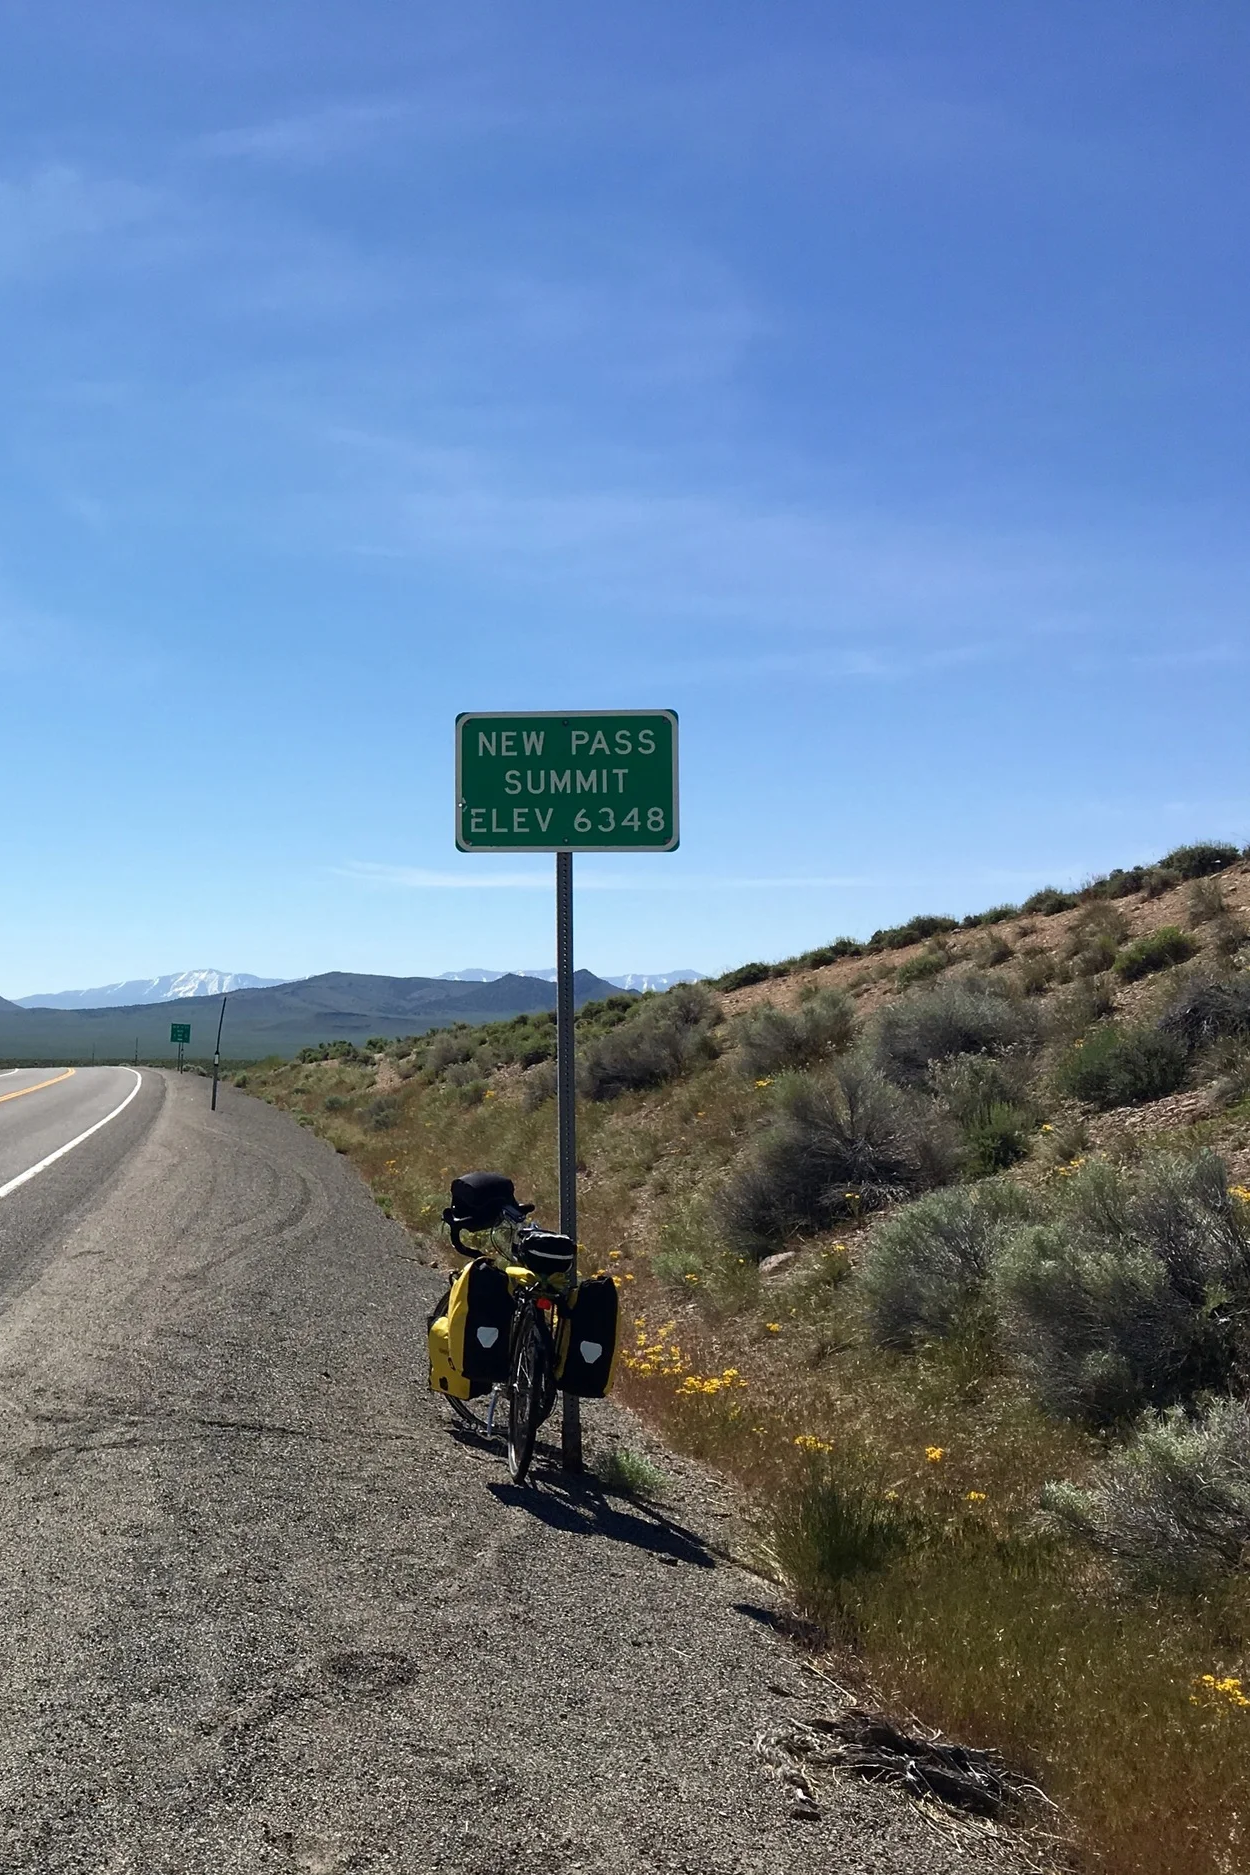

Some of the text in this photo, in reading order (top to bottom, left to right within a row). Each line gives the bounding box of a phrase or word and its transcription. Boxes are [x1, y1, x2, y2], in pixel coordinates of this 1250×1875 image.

[479, 730, 655, 756] NEW PASS
[505, 769, 628, 794] SUMMIT
[471, 807, 664, 832] ELEV 6348
